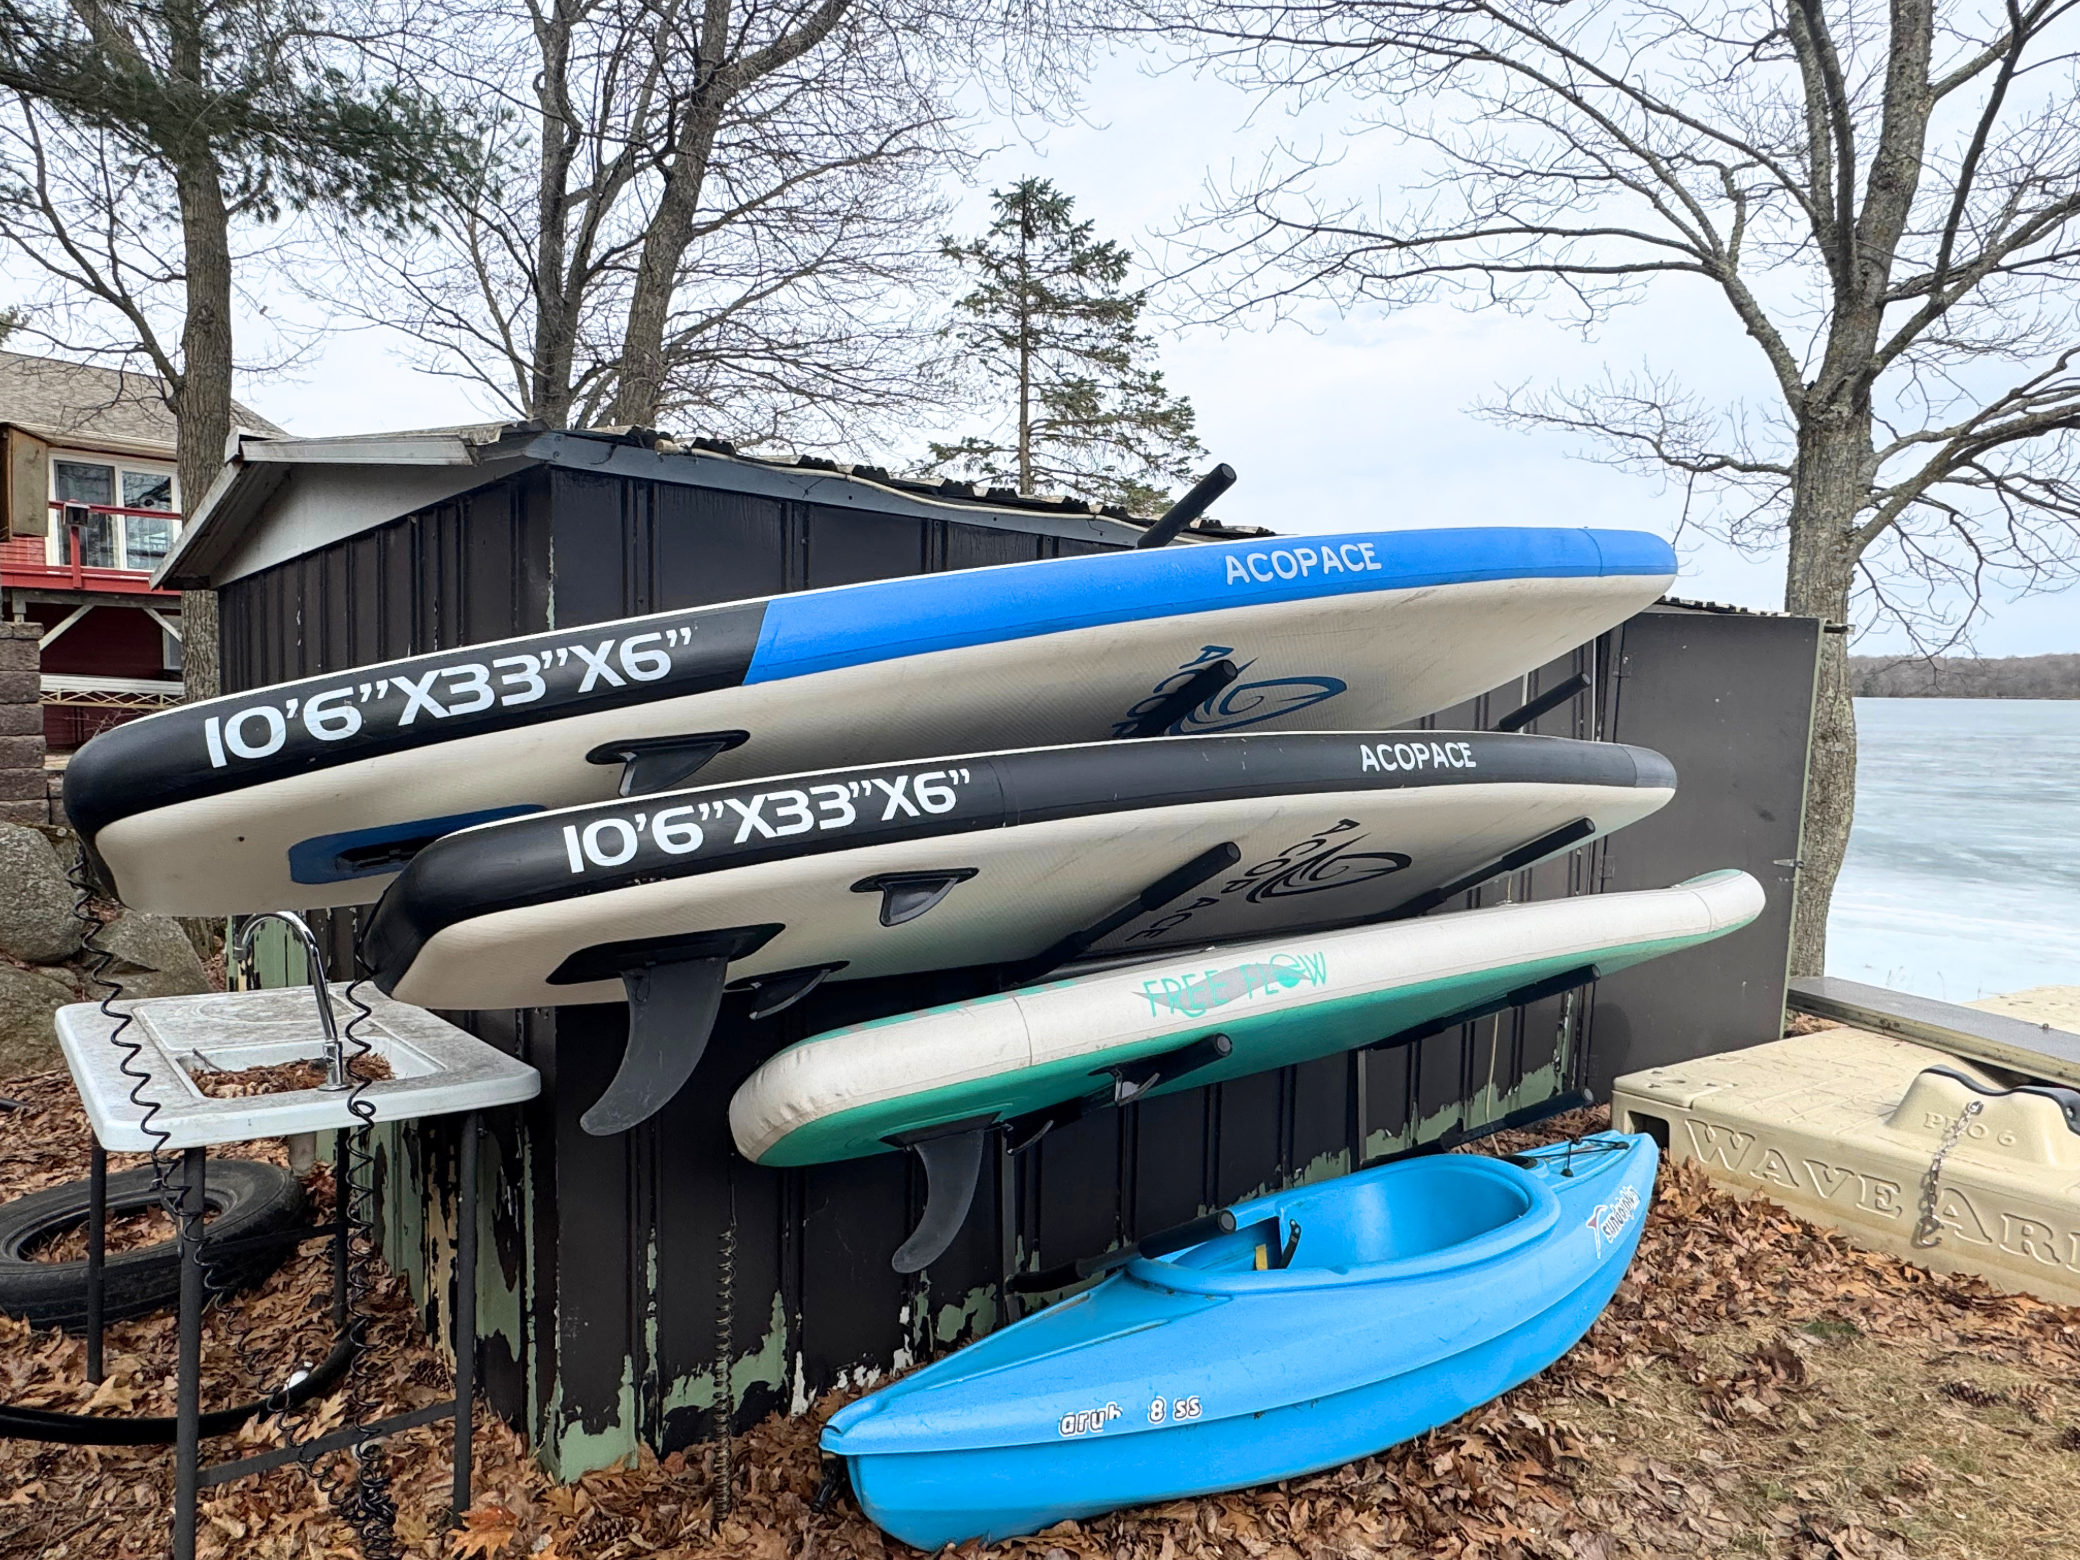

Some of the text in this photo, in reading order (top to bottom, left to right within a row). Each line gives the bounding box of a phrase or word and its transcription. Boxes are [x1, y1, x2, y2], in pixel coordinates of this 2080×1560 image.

[1225, 543, 1382, 585] ACOPACE
[1360, 742, 1477, 772] ACOPACE
[1142, 951, 1327, 1018] FREE FLOW
[1997, 1129, 2017, 1147] 6
[1684, 1118, 2080, 1274] WAVE AR
[1148, 1396, 1166, 1424] 8
